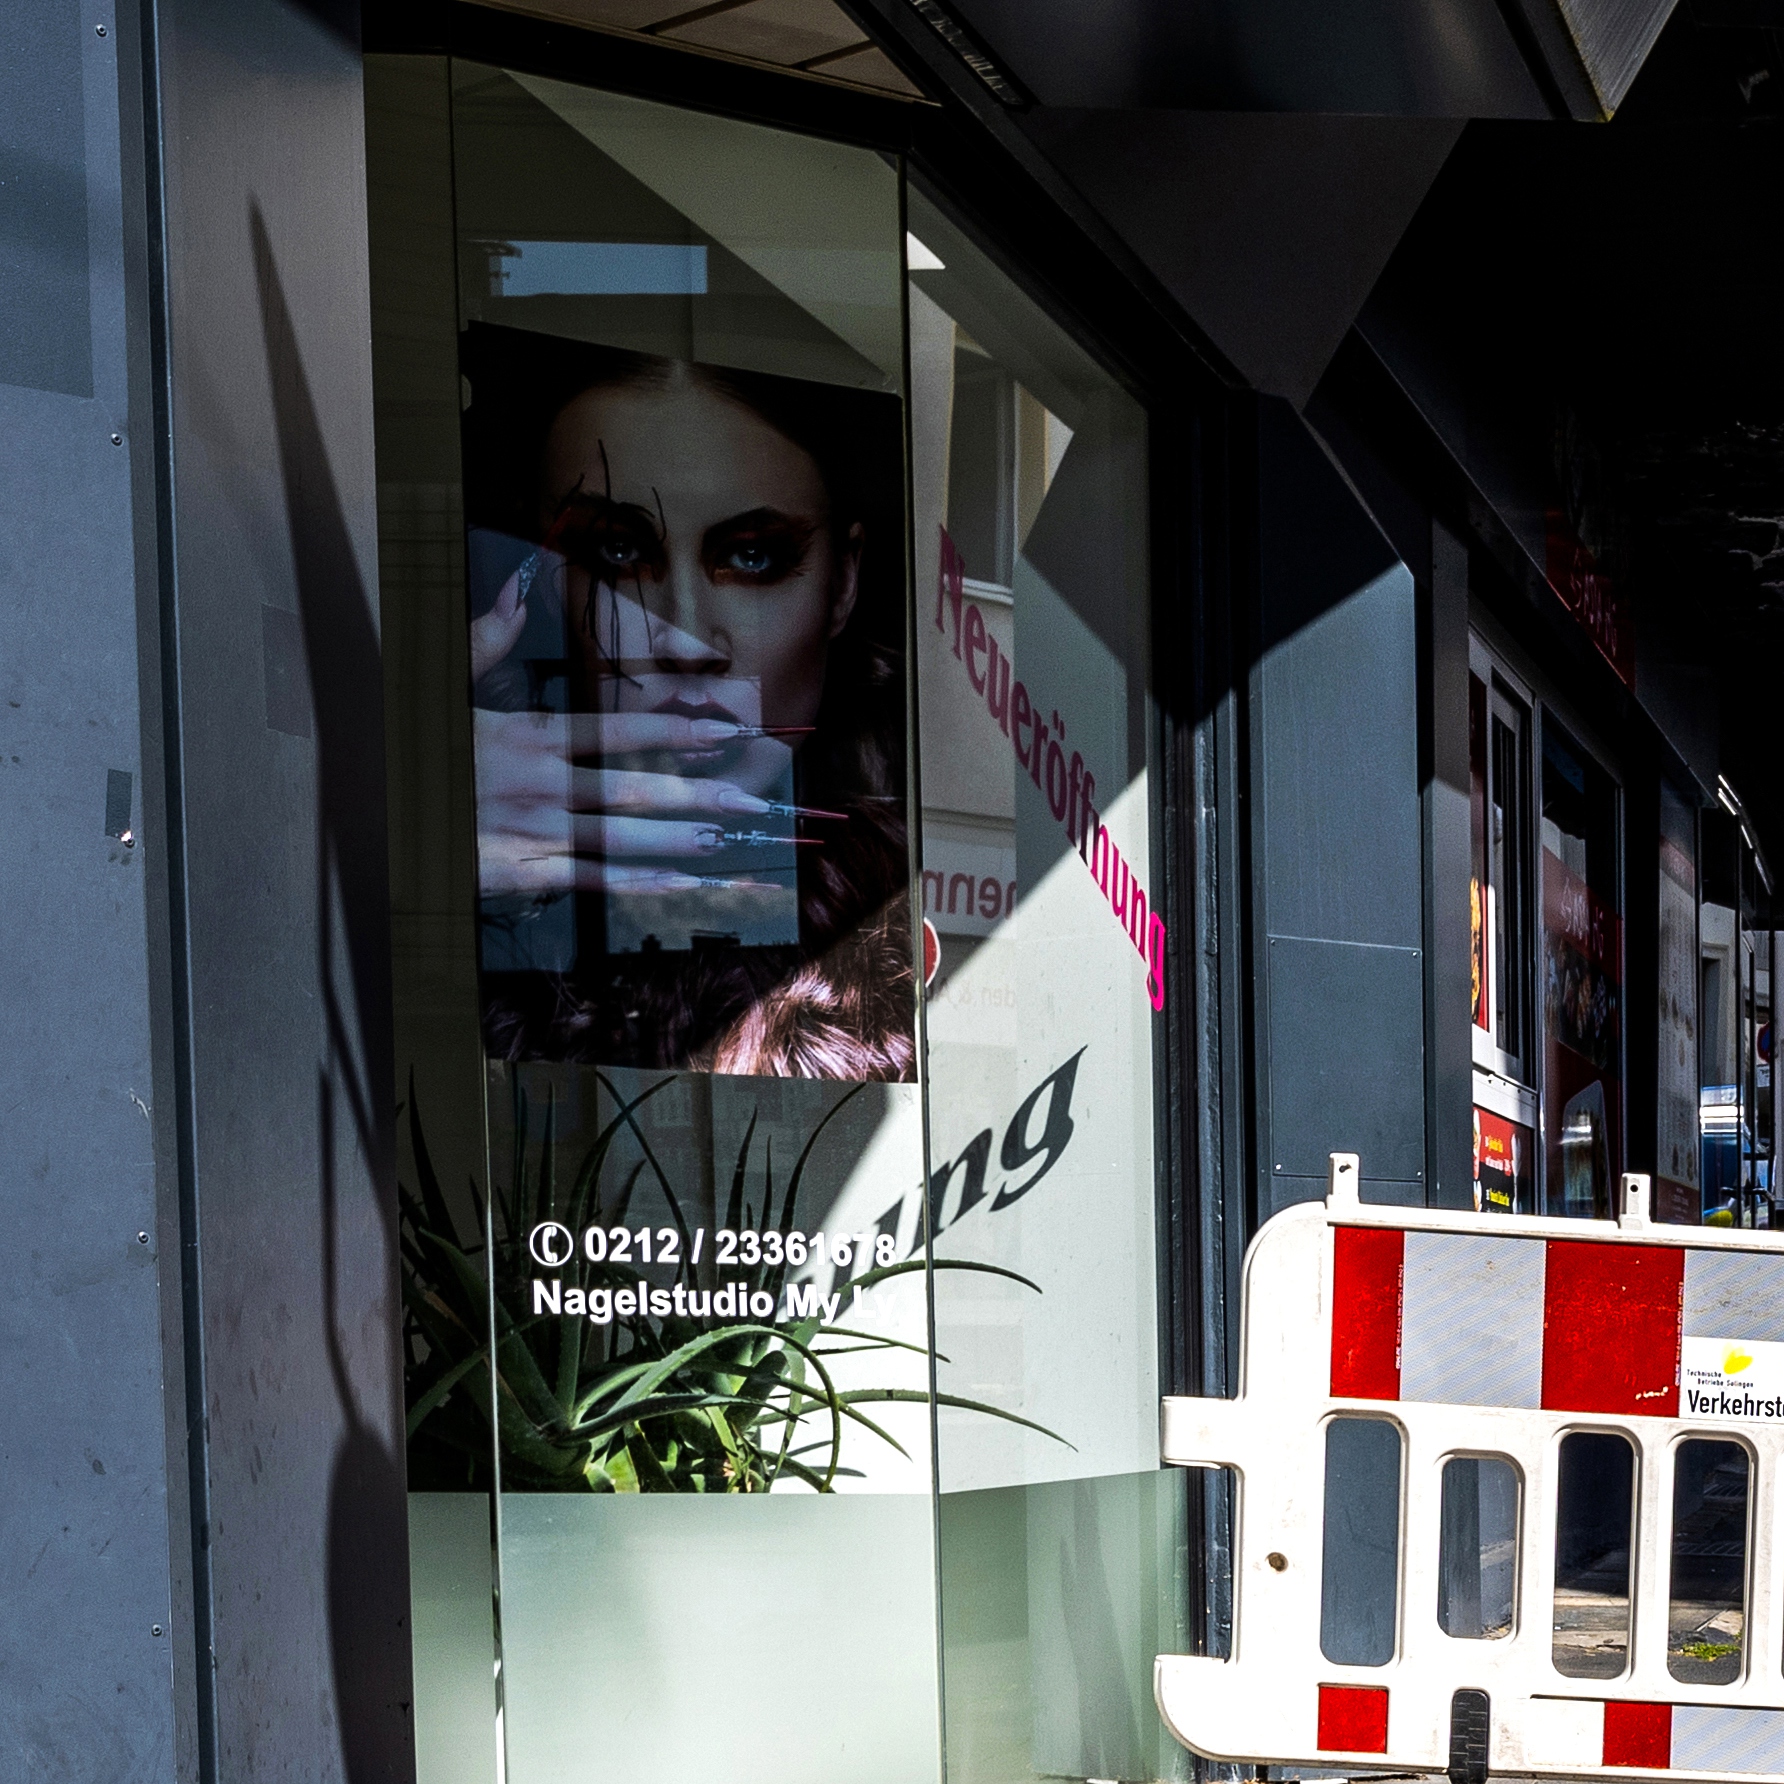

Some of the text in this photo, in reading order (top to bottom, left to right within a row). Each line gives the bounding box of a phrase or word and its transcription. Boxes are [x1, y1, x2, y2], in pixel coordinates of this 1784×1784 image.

[936, 524, 1166, 1011] Neueröffnung
[584, 1227, 898, 1268] 0212 / 23361678
[533, 1278, 775, 1324] Nagelstudio
[786, 1284, 842, 1326] My
[1687, 1369, 1722, 1378] Technische
[1698, 1378, 1754, 1388] Betriebe Solingen
